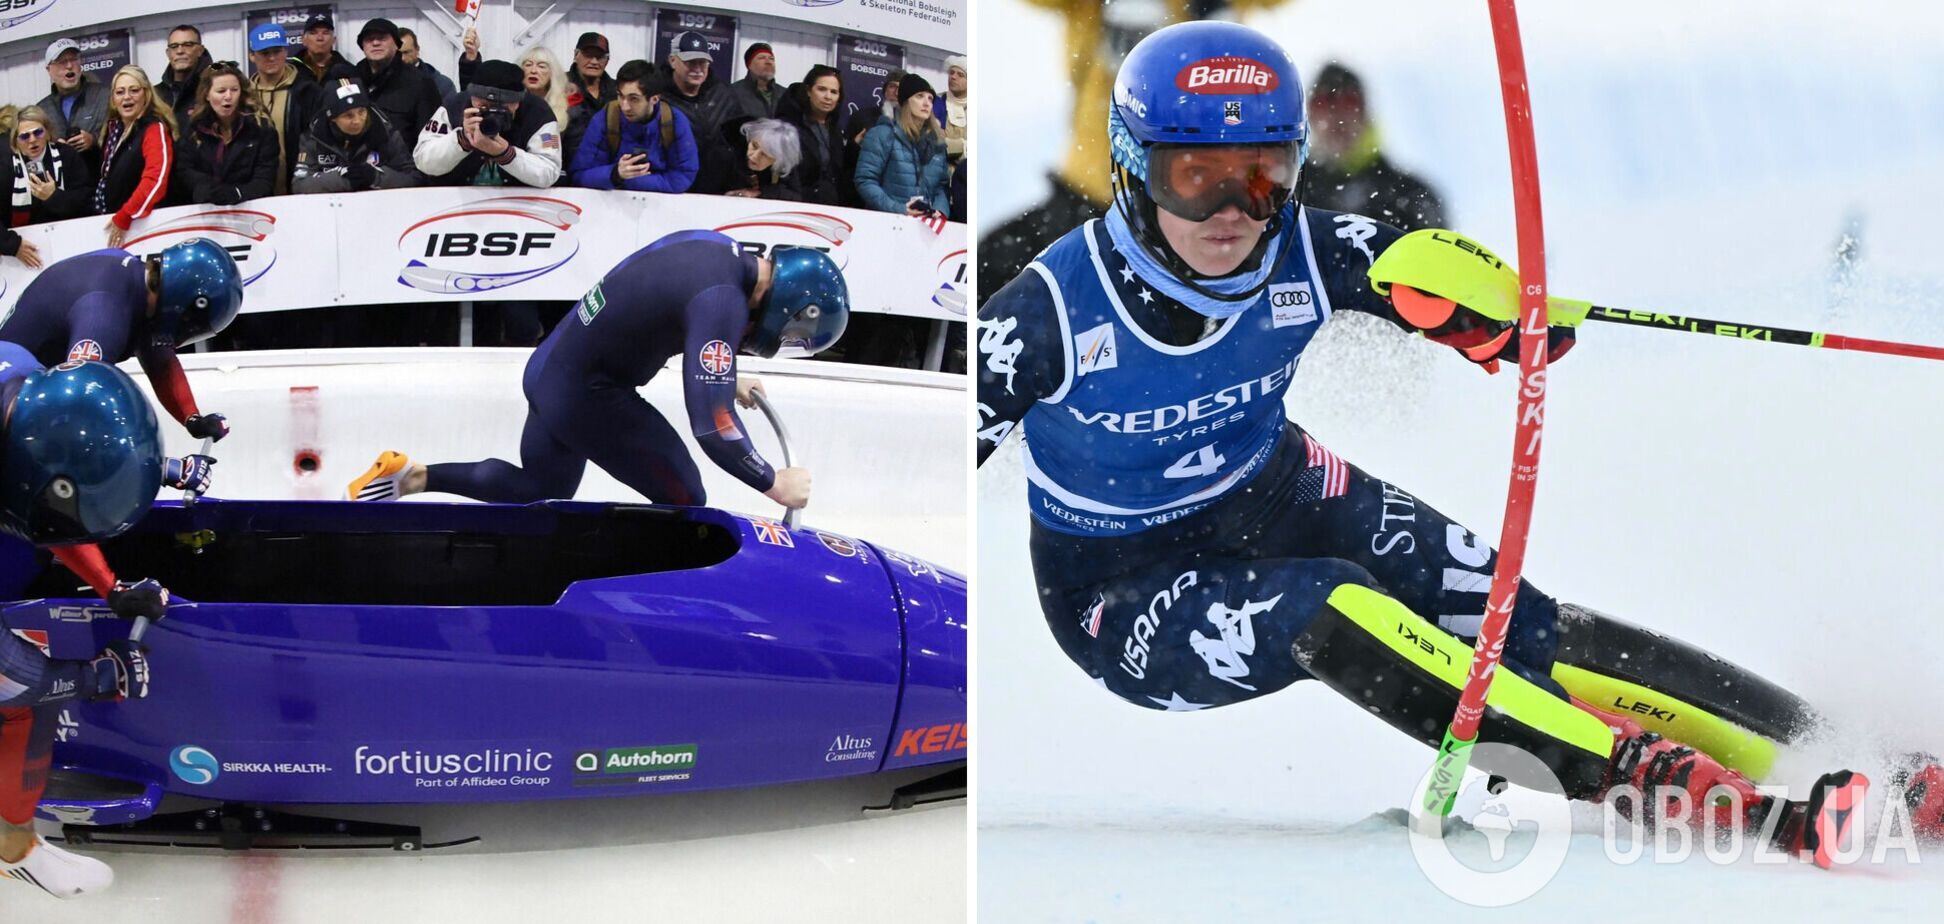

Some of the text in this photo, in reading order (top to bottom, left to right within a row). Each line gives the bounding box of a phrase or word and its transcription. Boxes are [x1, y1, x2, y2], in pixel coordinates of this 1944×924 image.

[869, 0, 907, 16] Skeleton
[908, 8, 952, 26] Federation
[918, 1, 957, 18] Bobsleigh
[680, 13, 717, 30] 1997
[79, 34, 110, 51] 983
[258, 31, 281, 40] USA
[853, 39, 888, 57] 2003
[850, 63, 889, 77] BOBSLED
[1188, 64, 1272, 88] Barilla
[1225, 102, 1240, 110] US
[425, 120, 448, 135] USA
[318, 154, 337, 165] EA7
[424, 232, 556, 257] IBSF
[1432, 233, 1502, 270] LEKI
[1526, 284, 1542, 295] C6
[1605, 306, 1686, 327] LEKI
[977, 402, 1015, 447] SA
[1152, 410, 1246, 446] TYRES
[1163, 441, 1226, 479] 4
[1043, 497, 1126, 530] VREDESTEIN
[1119, 570, 1198, 680] USANA
[1398, 622, 1451, 666] LEKI
[1613, 696, 1676, 722] LEKI
[829, 734, 872, 751] Altus
[354, 746, 553, 775] fortiusclinic
[606, 750, 693, 768] Autohorn
[825, 750, 876, 762] Consulting
[223, 762, 272, 773] SIRKKA
[415, 775, 550, 788] Part of Affidea Group
[638, 773, 690, 783] FLEET SERVICES
